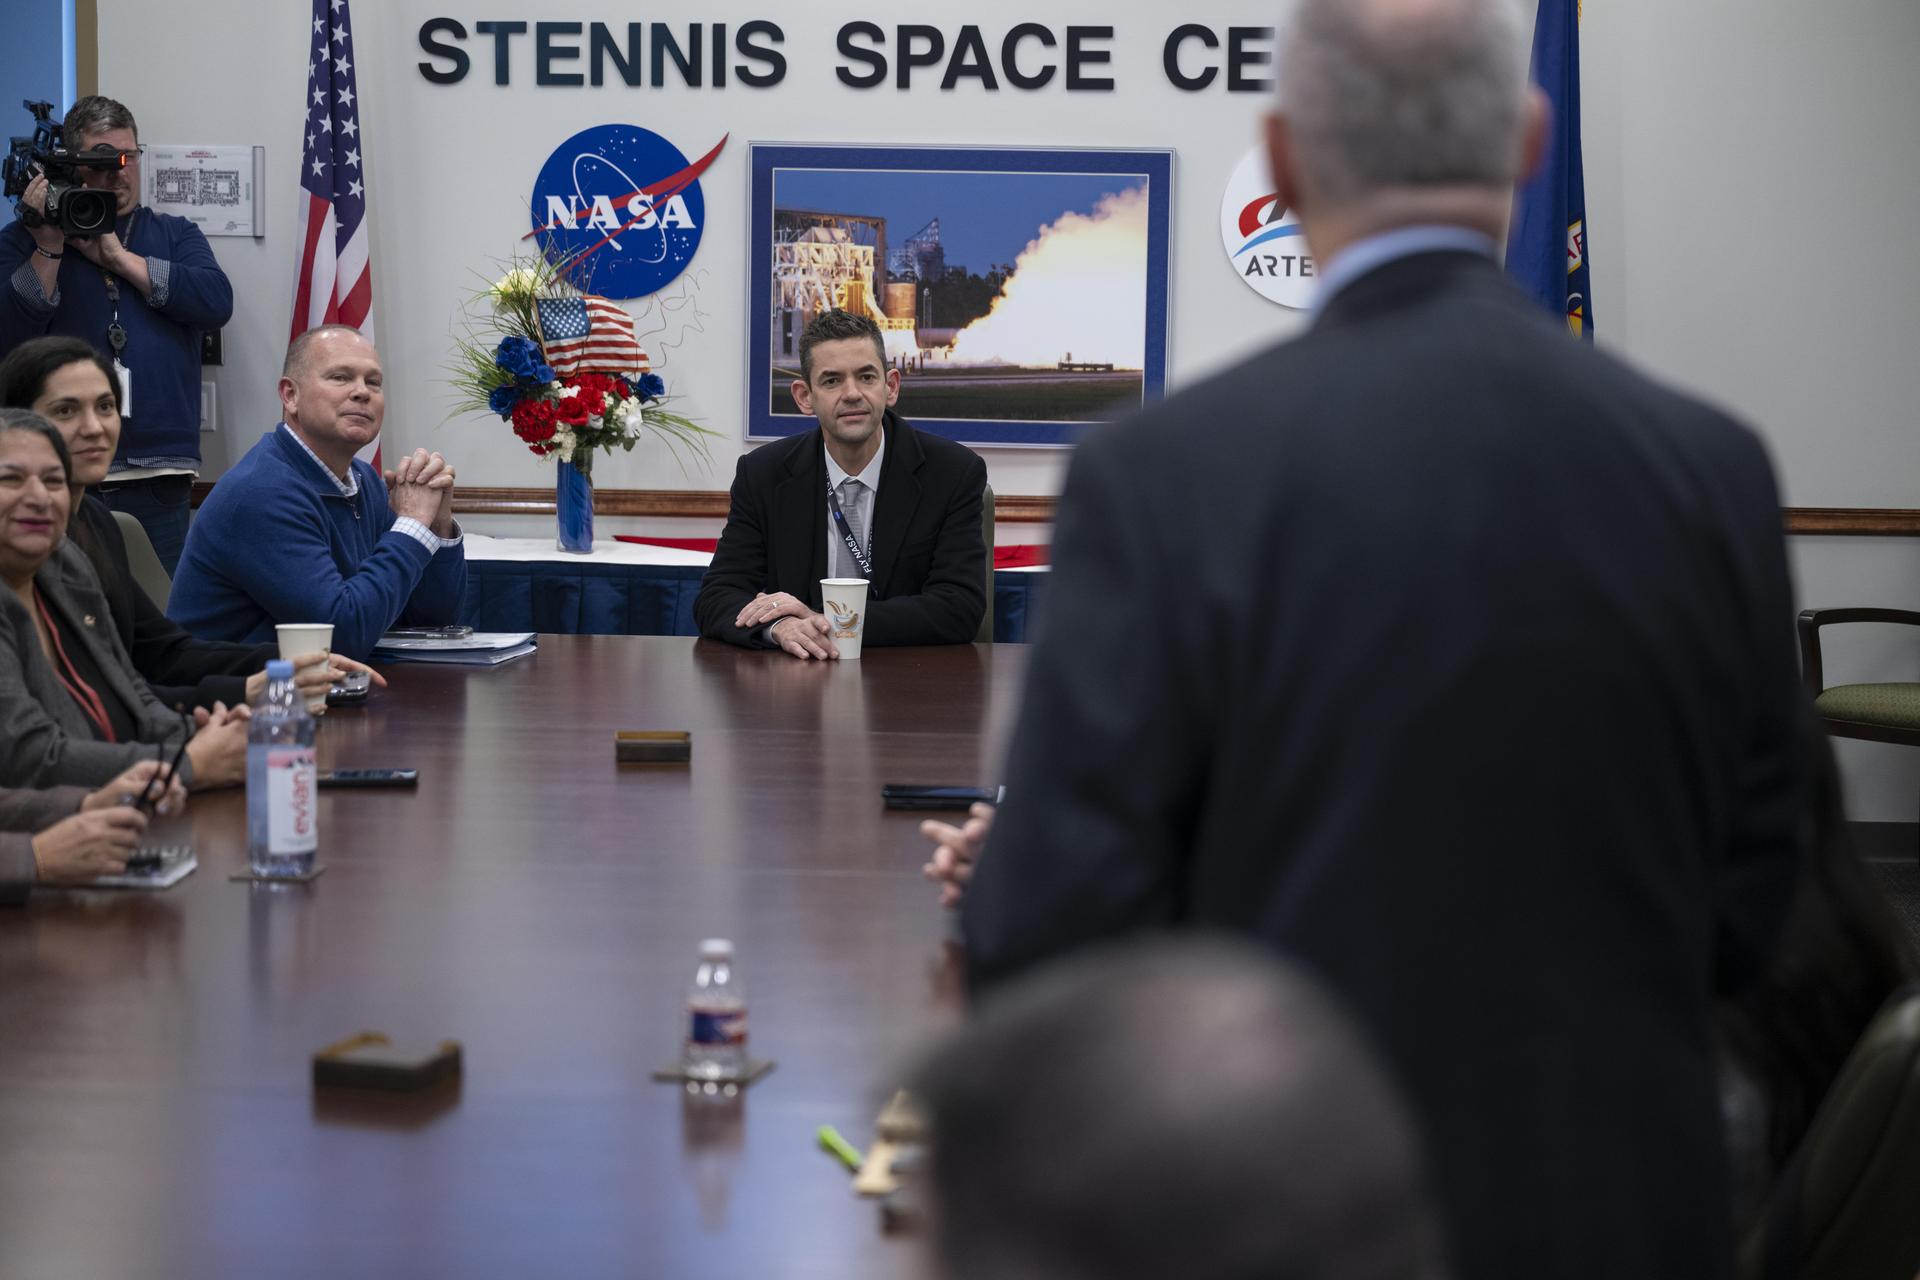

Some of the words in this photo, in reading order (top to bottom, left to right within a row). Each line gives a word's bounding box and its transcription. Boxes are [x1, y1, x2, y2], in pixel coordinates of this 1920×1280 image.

[418, 17, 787, 88] STENNIS
[836, 21, 1115, 91] SPACE
[545, 194, 696, 230] NASA
[845, 534, 863, 559] NASA
[859, 559, 872, 574] FLY
[291, 769, 310, 836] evian
